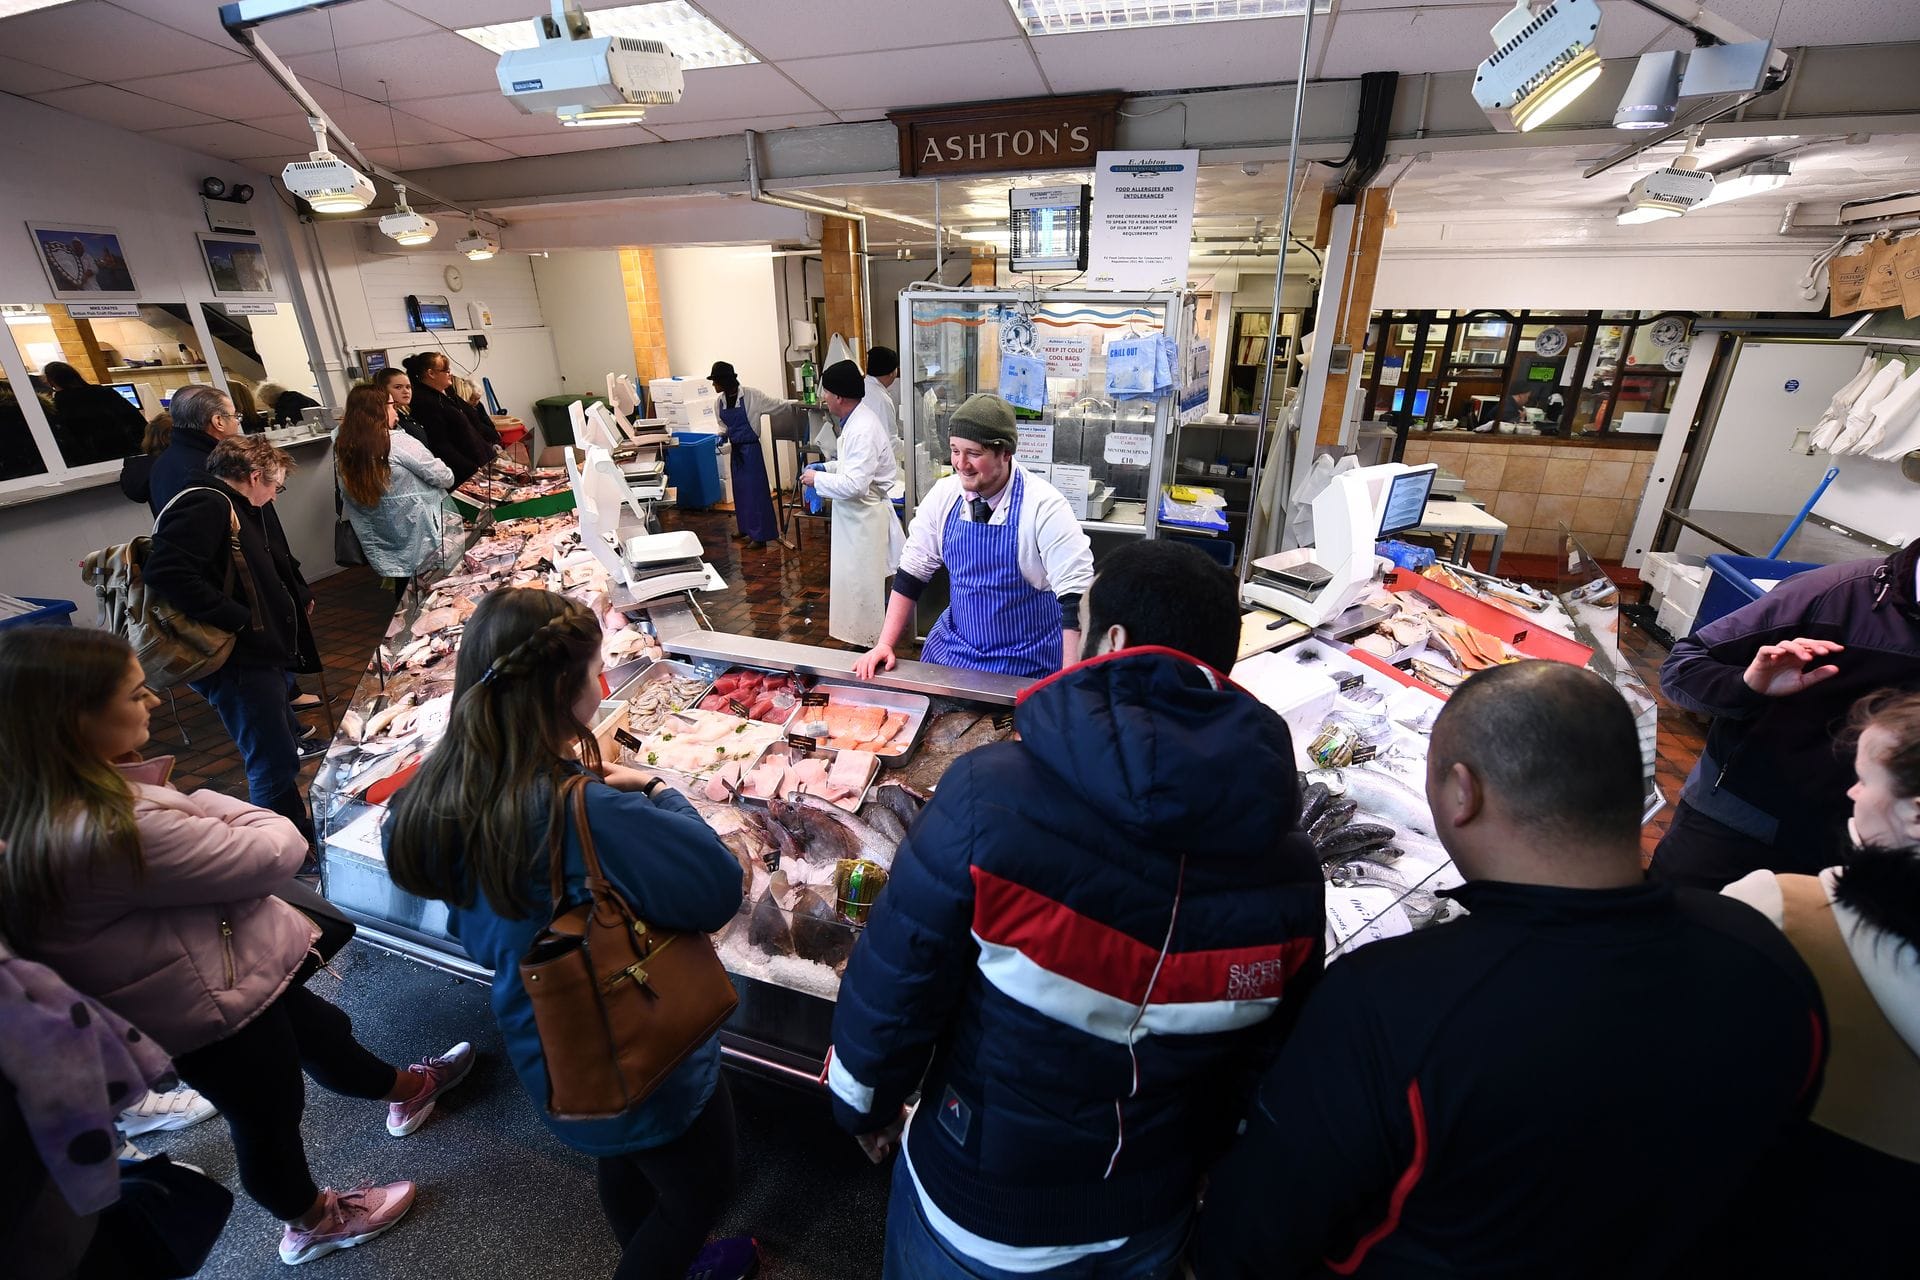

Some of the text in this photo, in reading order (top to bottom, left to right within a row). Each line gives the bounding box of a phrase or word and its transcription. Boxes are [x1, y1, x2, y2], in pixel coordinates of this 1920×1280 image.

[921, 122, 1090, 163] ASHTON'S
[1110, 347, 1138, 358] CHILL OUT
[1230, 959, 1281, 978] SUPER
